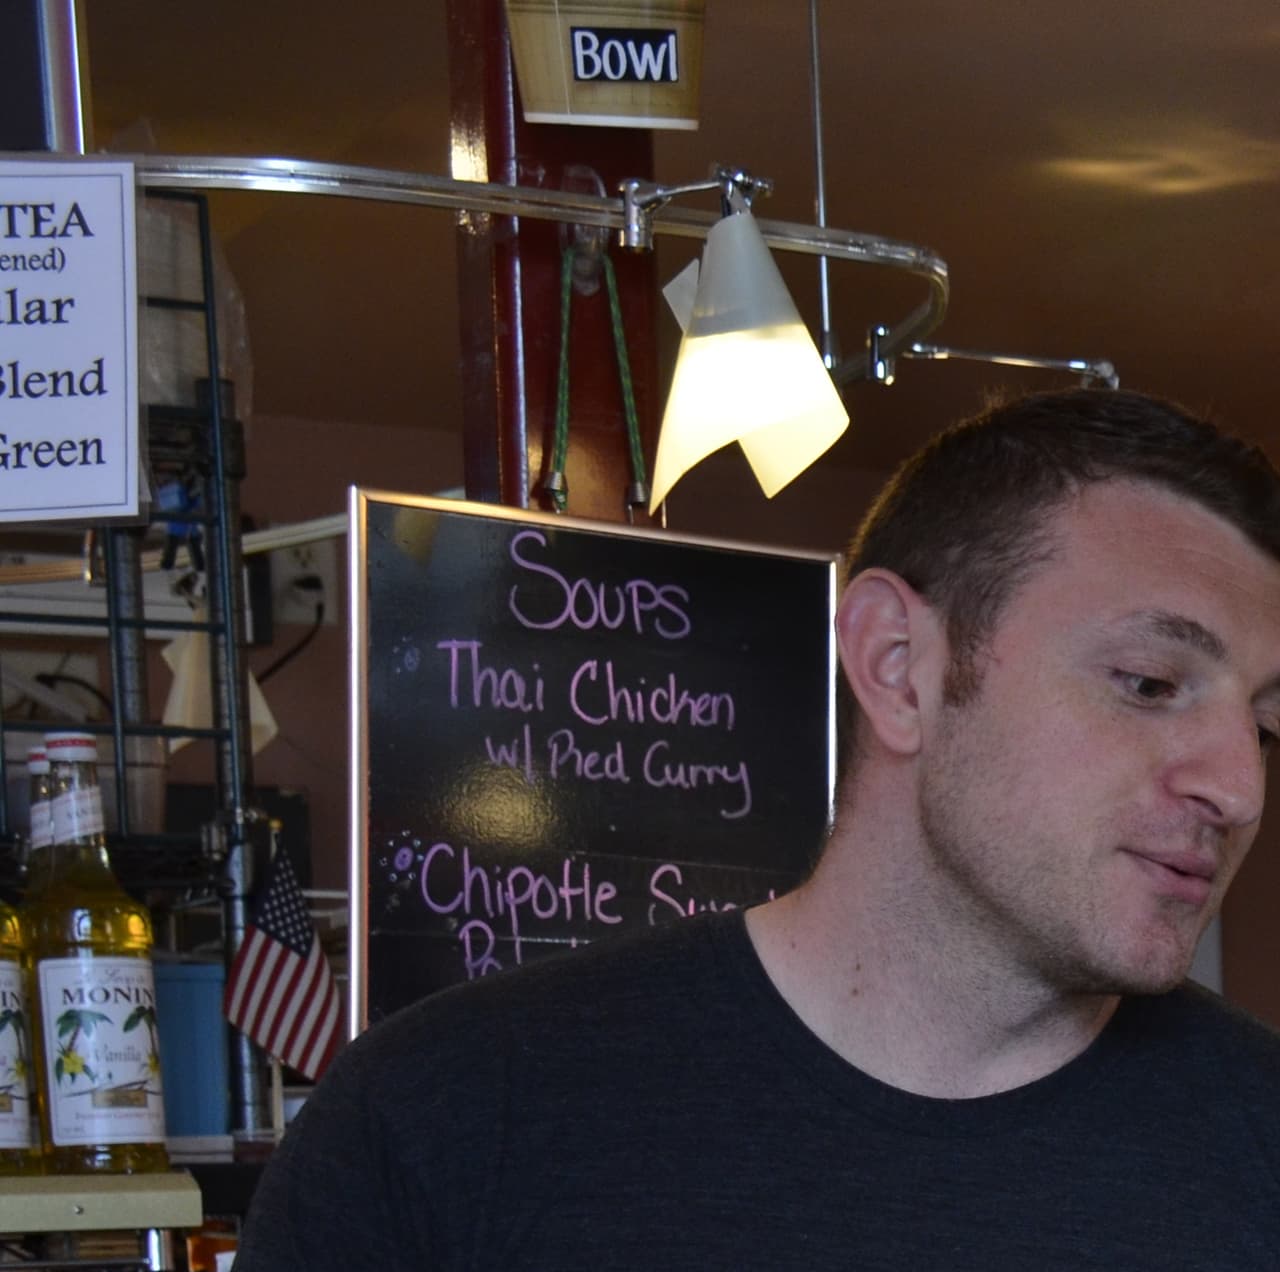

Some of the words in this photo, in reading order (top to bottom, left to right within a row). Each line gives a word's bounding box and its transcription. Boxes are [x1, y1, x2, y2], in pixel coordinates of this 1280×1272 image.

[574, 30, 678, 81] Bowl
[1, 202, 95, 239] TEA
[0, 287, 76, 326] lar
[510, 530, 692, 640] Soups
[436, 638, 545, 712] Thai
[570, 660, 736, 731] Chicken
[643, 740, 753, 820] Curry
[421, 843, 623, 965] Chipotle
